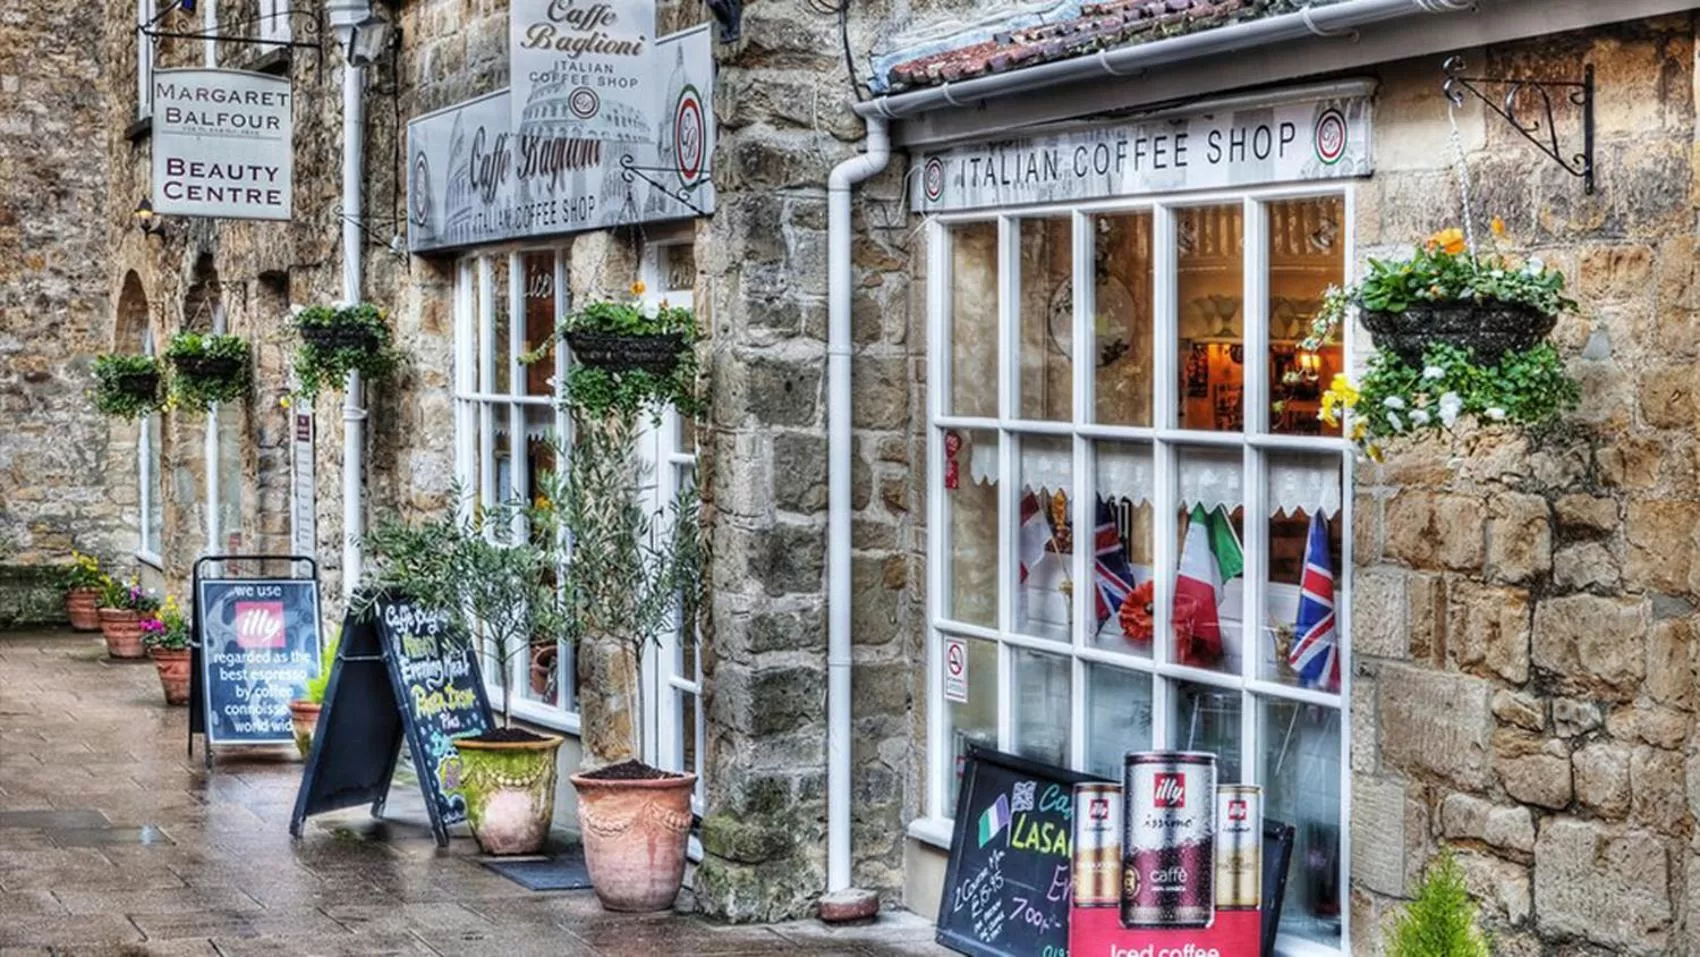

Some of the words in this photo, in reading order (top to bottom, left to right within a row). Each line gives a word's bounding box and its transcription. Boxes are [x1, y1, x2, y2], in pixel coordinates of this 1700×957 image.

[520, 22, 646, 59] Baglioni
[554, 60, 614, 74] ITALIAN
[529, 71, 591, 85] COFFEE
[597, 76, 638, 88] SHOP
[960, 150, 1057, 188] ITALIAN
[1073, 132, 1188, 177] COFFEE
[1207, 122, 1296, 164] SHOP
[166, 157, 279, 181] BEAUTY
[163, 181, 282, 205] CENTRE
[472, 208, 514, 234] ITALIAN
[515, 200, 557, 229] COFFEE
[562, 194, 594, 223] SHOP
[234, 586, 254, 597] we
[257, 586, 282, 597] use
[242, 609, 281, 642] illy
[214, 650, 271, 668] regarded
[274, 653, 288, 663] as
[291, 650, 312, 663] the
[220, 667, 248, 681] best
[249, 670, 308, 685] espresso
[236, 685, 252, 702] by
[255, 685, 294, 699] coffee
[235, 718, 271, 733] world
[272, 718, 295, 733] wid
[1155, 778, 1183, 805] illy
[1012, 813, 1072, 858] LASA
